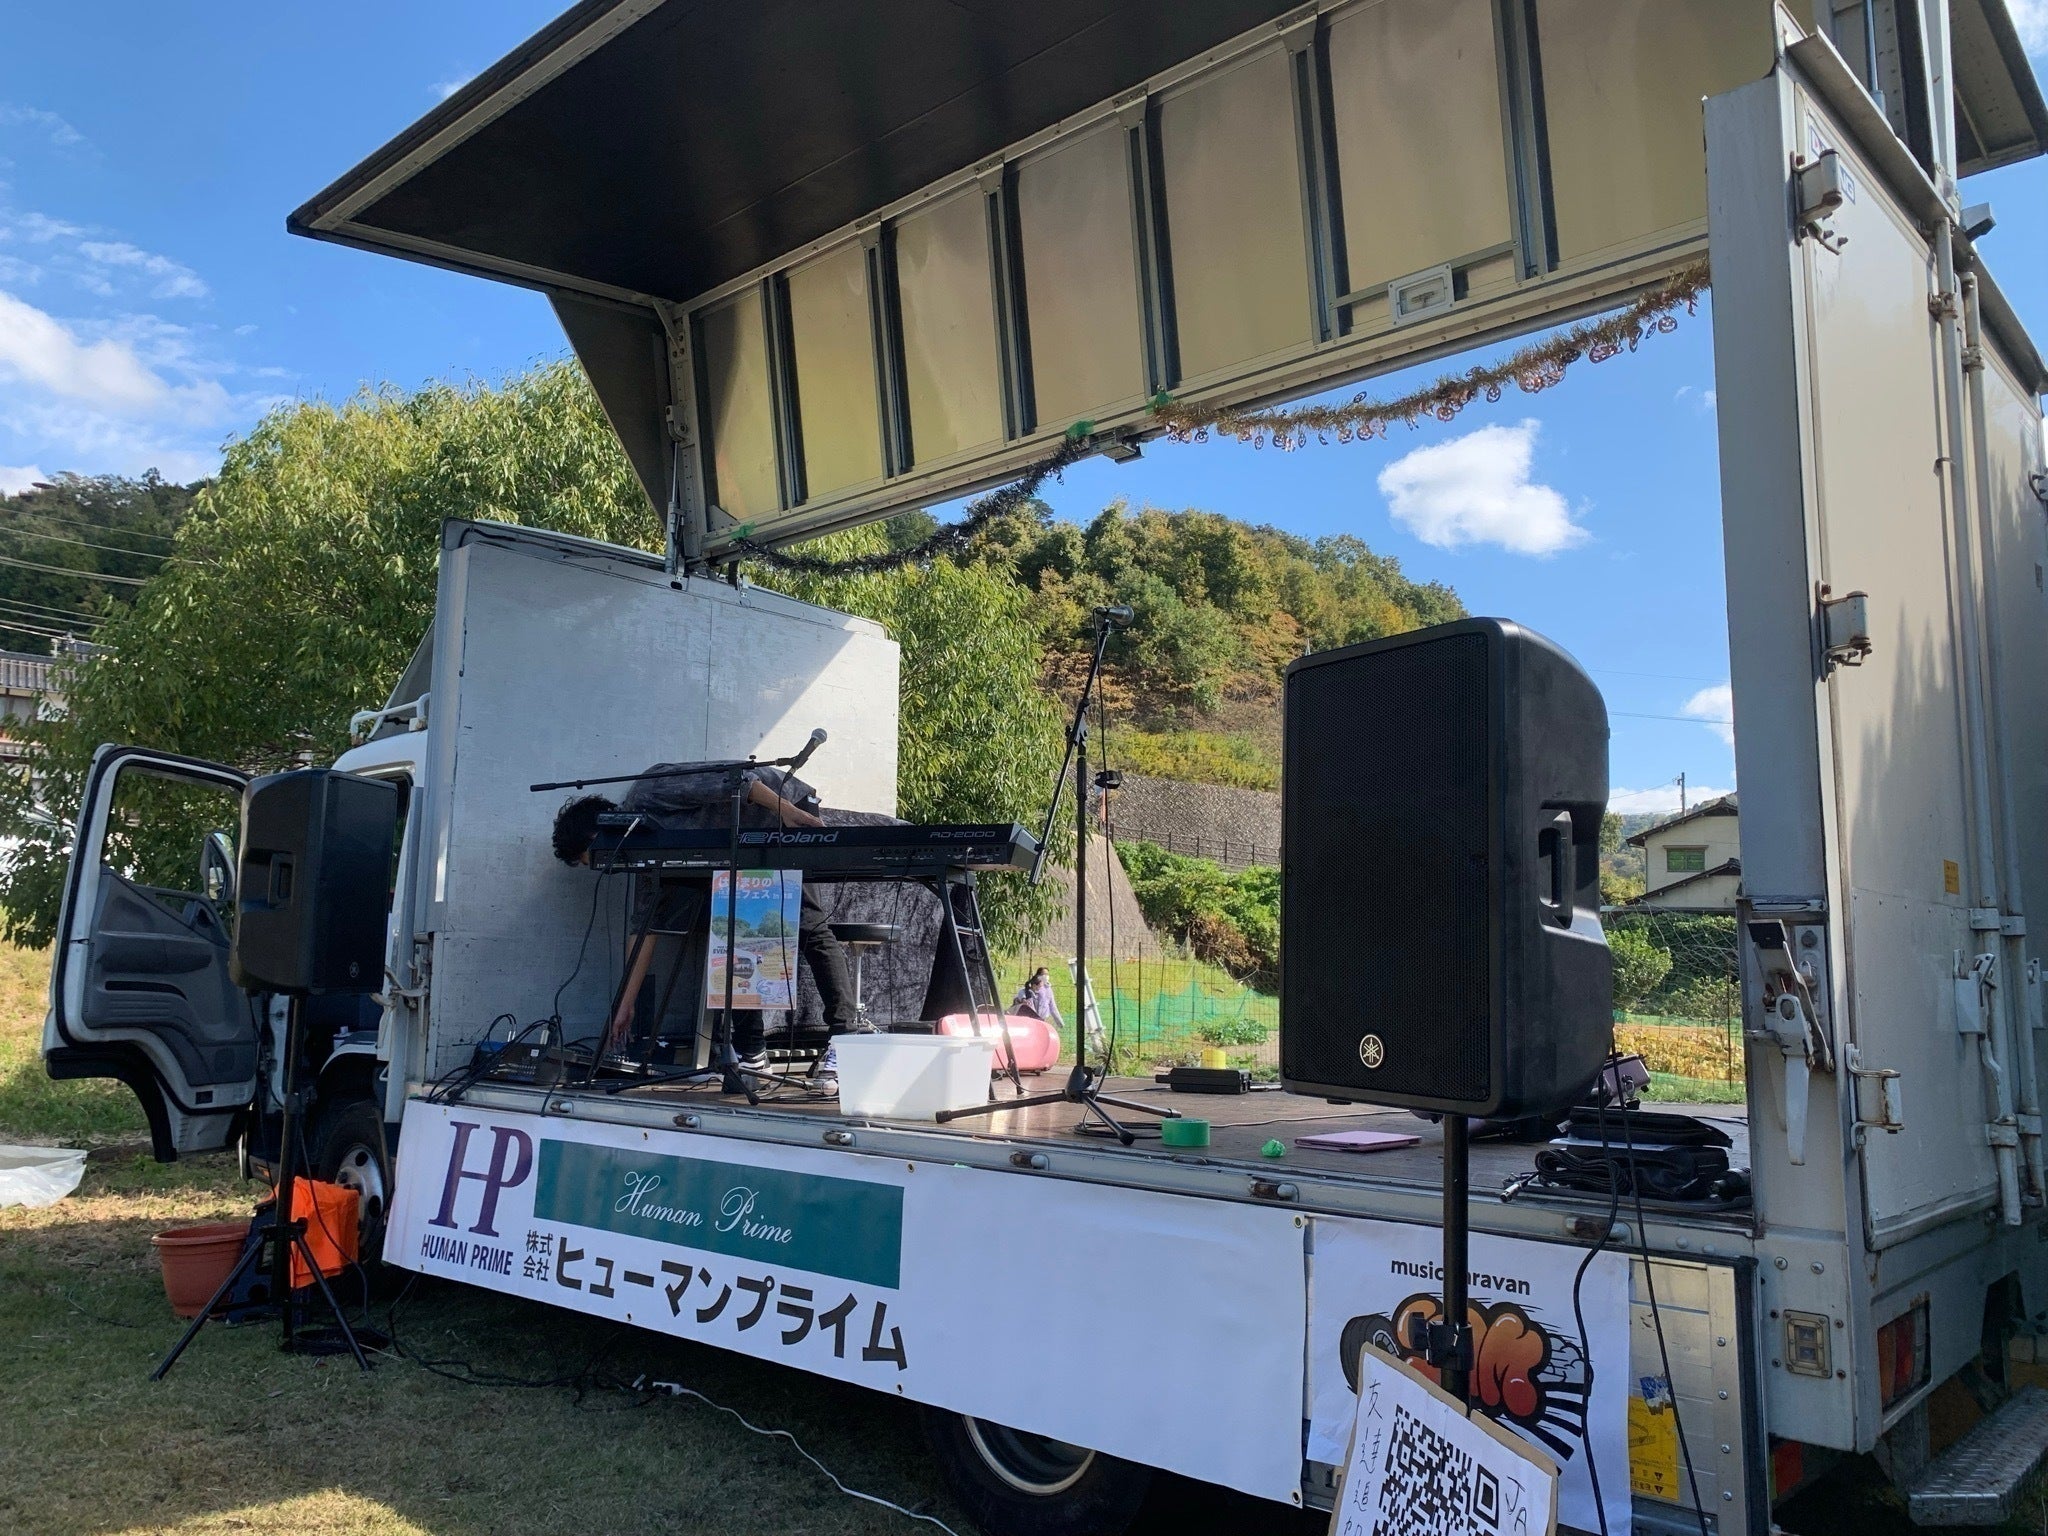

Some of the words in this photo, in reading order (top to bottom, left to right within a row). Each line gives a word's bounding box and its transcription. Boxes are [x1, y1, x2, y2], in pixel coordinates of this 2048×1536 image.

[767, 831, 839, 844] Roland
[929, 830, 996, 838] RD-2000
[718, 876, 774, 889] はまりの
[428, 1120, 533, 1238] HP
[613, 1170, 703, 1228] Human
[714, 1185, 793, 1245] Prime
[421, 1234, 467, 1267] HUMAN
[470, 1246, 514, 1276] PRIME
[526, 1229, 553, 1256] 株式
[523, 1254, 550, 1282] 会社
[555, 1236, 908, 1371] ヒューマンプライム
